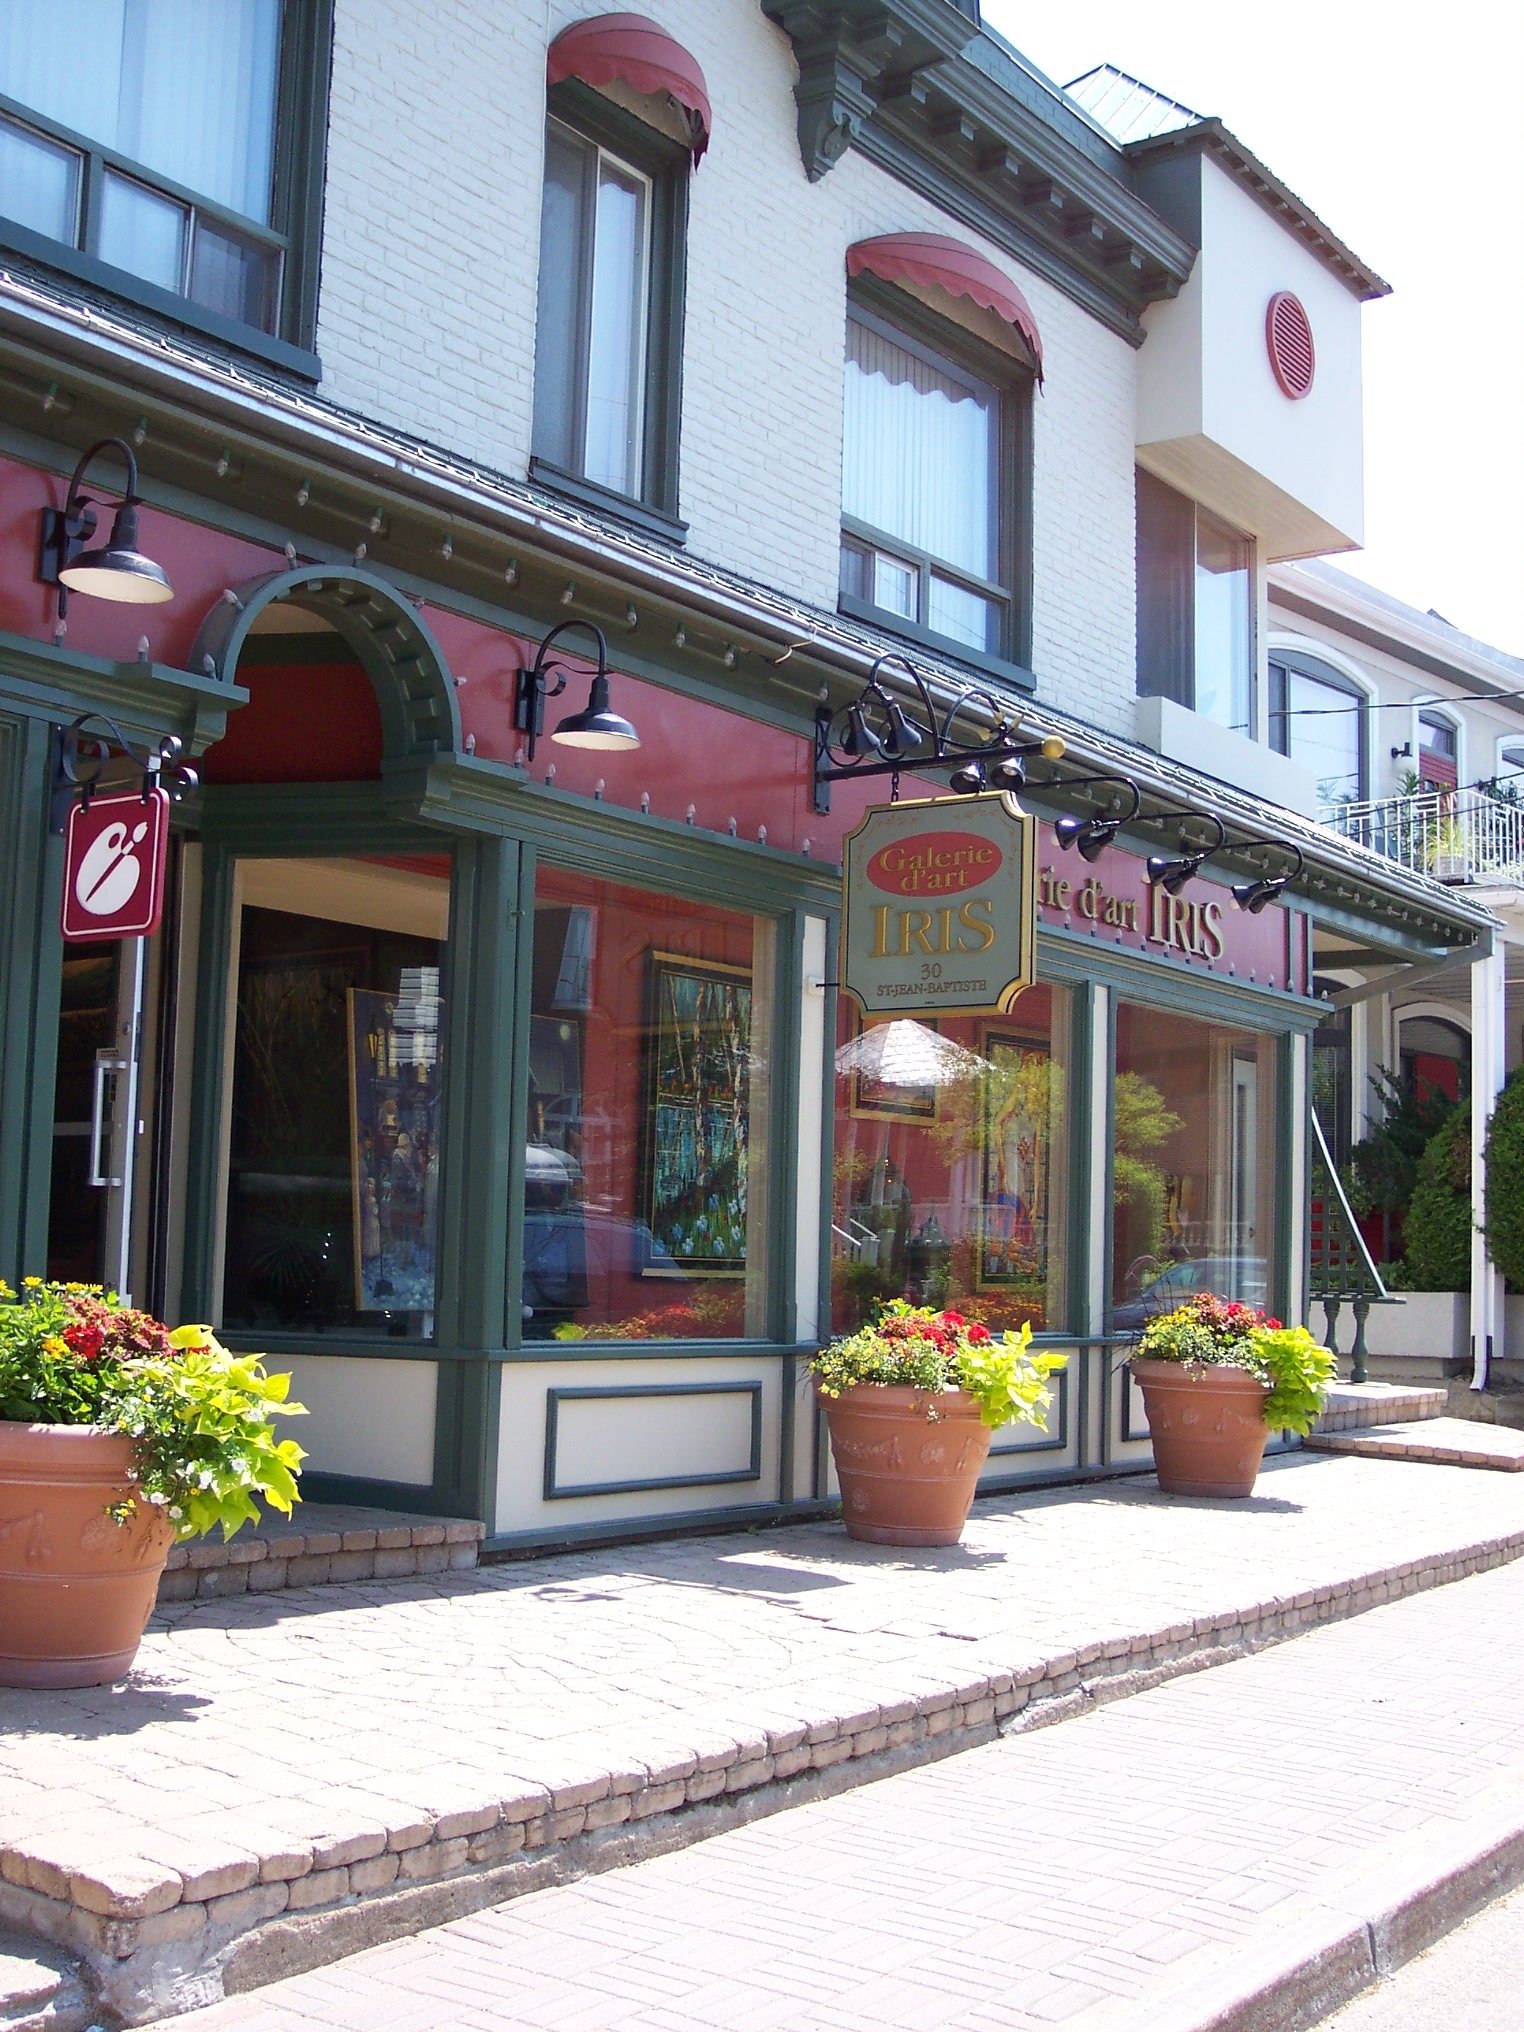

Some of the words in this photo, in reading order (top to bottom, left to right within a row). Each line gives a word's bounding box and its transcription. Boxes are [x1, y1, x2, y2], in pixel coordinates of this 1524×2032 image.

[879, 845, 993, 872] Galerie
[900, 869, 968, 892] d'art
[868, 899, 996, 959] IRIS
[1078, 877, 1140, 933] d'art
[1149, 881, 1225, 960] IRIS
[921, 962, 943, 981] 30
[876, 979, 988, 998] ST-JEAN-BAPTISTE
